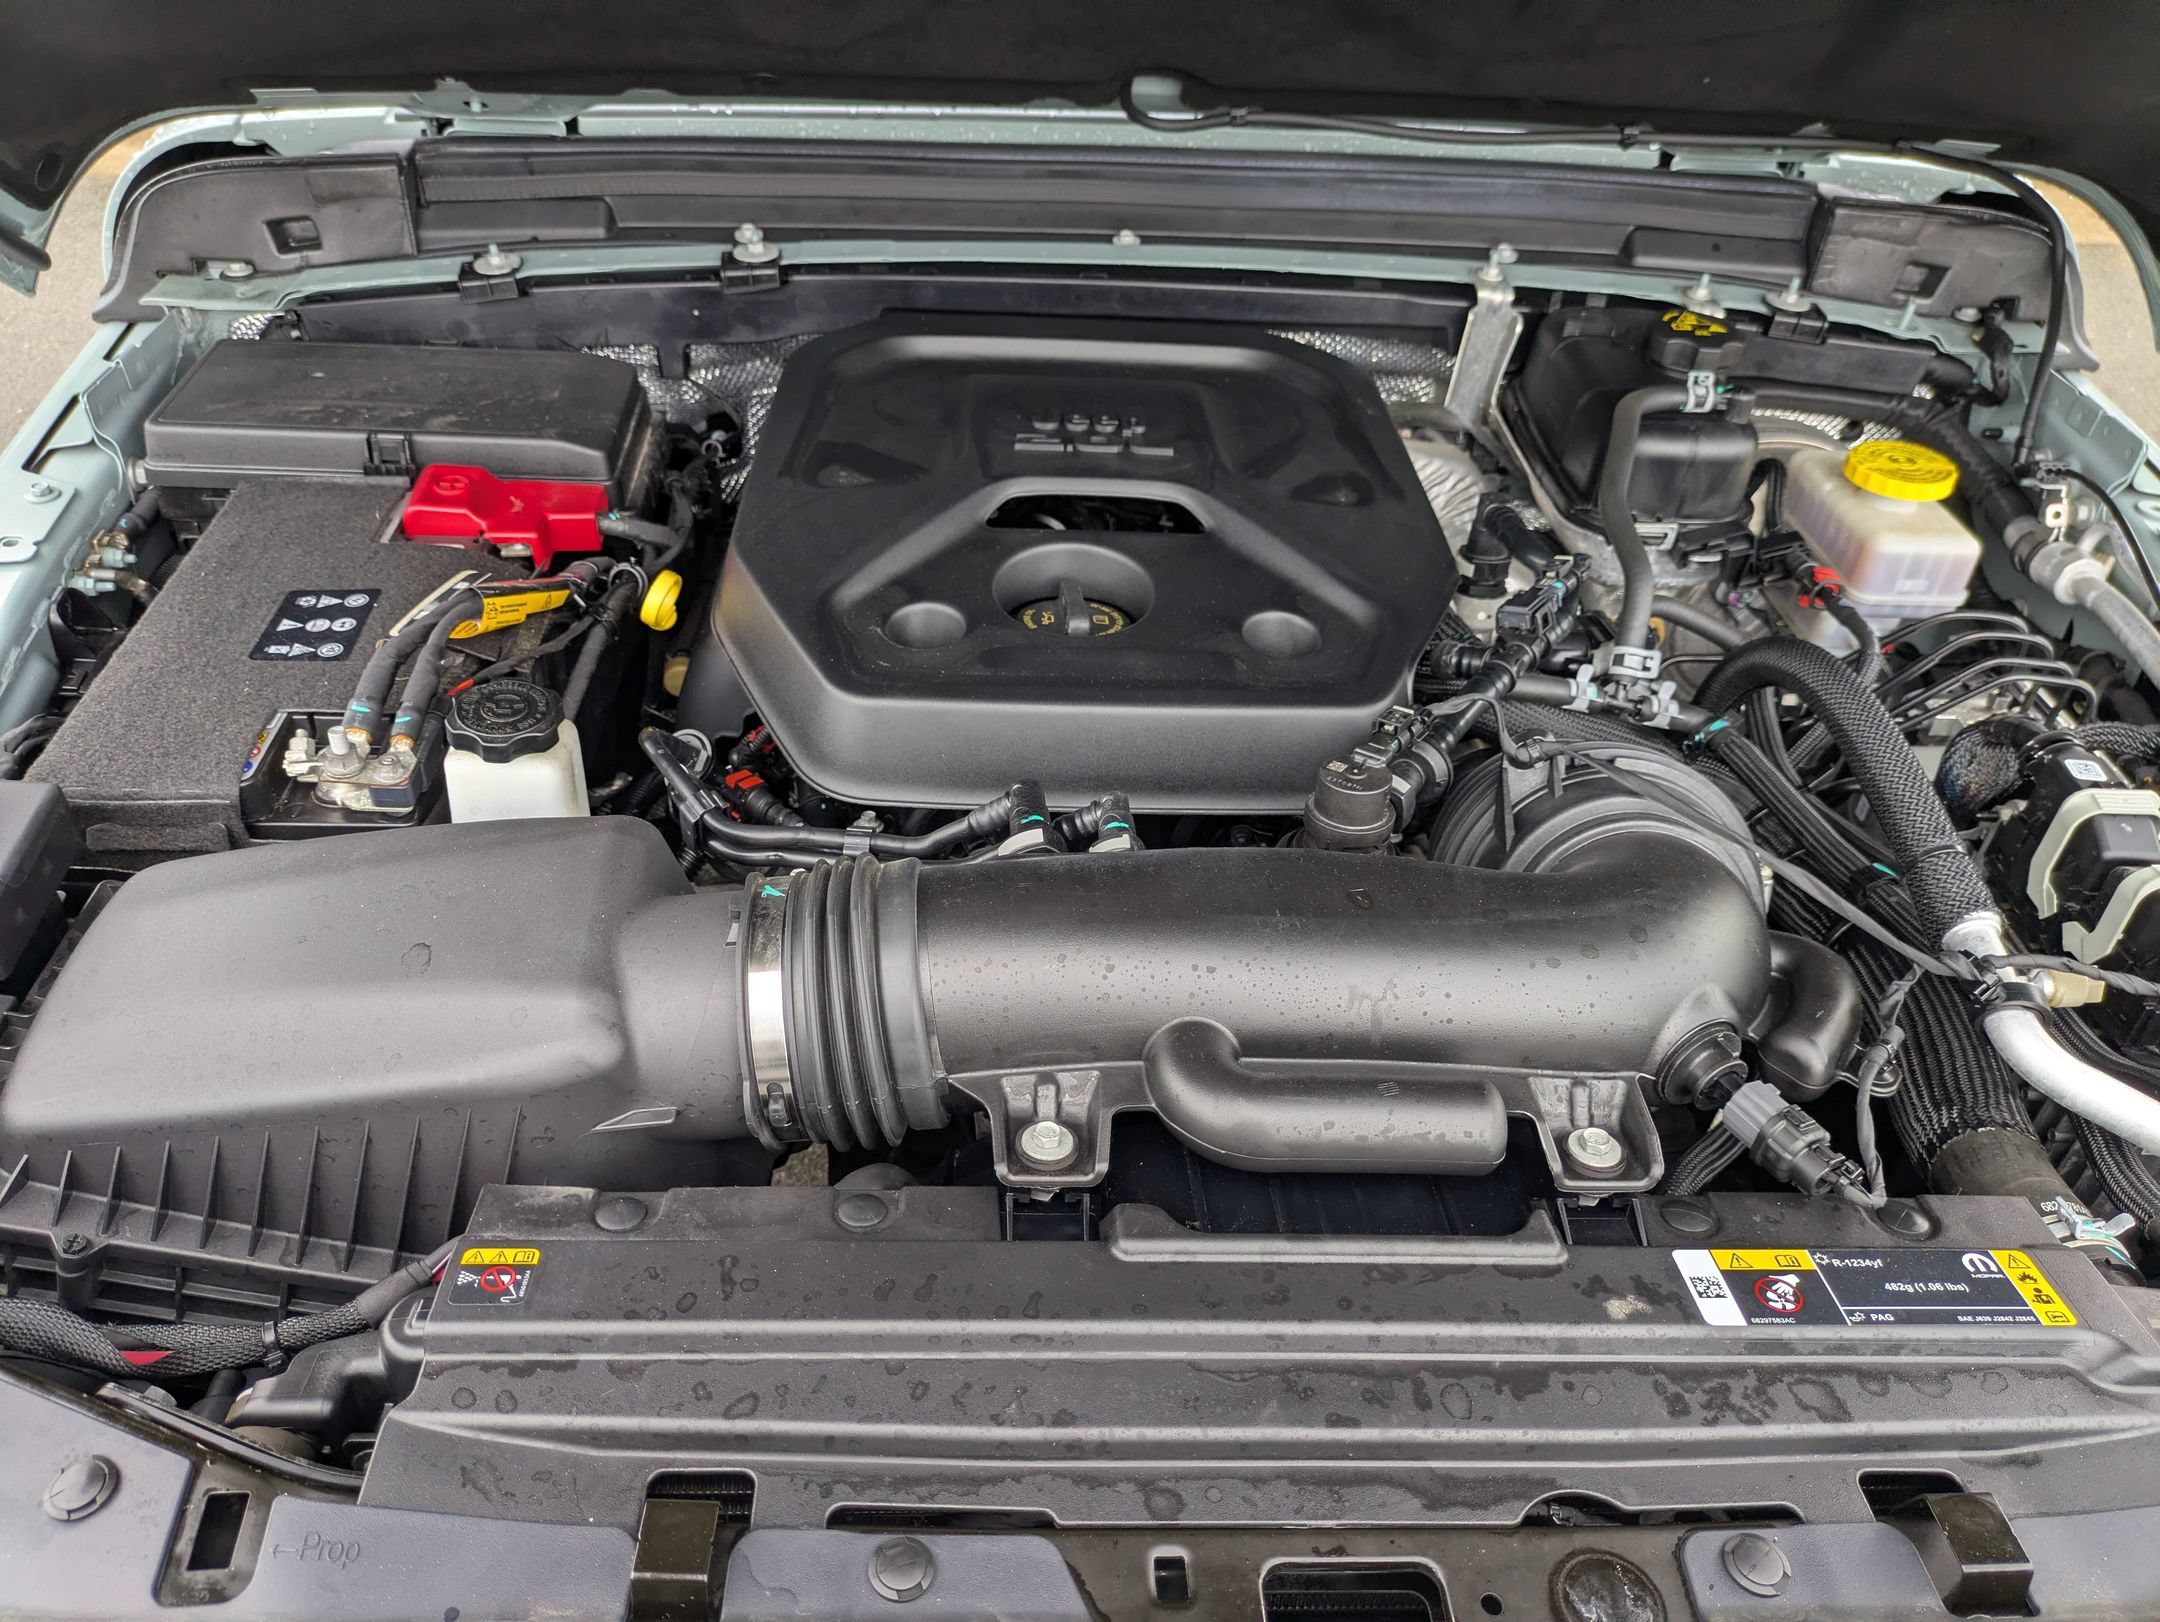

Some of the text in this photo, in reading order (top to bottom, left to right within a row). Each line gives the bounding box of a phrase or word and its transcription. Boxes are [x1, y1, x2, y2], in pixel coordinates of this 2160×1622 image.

[1832, 1258, 1884, 1269] R-1234yf
[1885, 1282, 1970, 1293] 482g (1.06 lbs)
[1871, 1313, 1895, 1322] PAG
[300, 1531, 361, 1570] Prop
